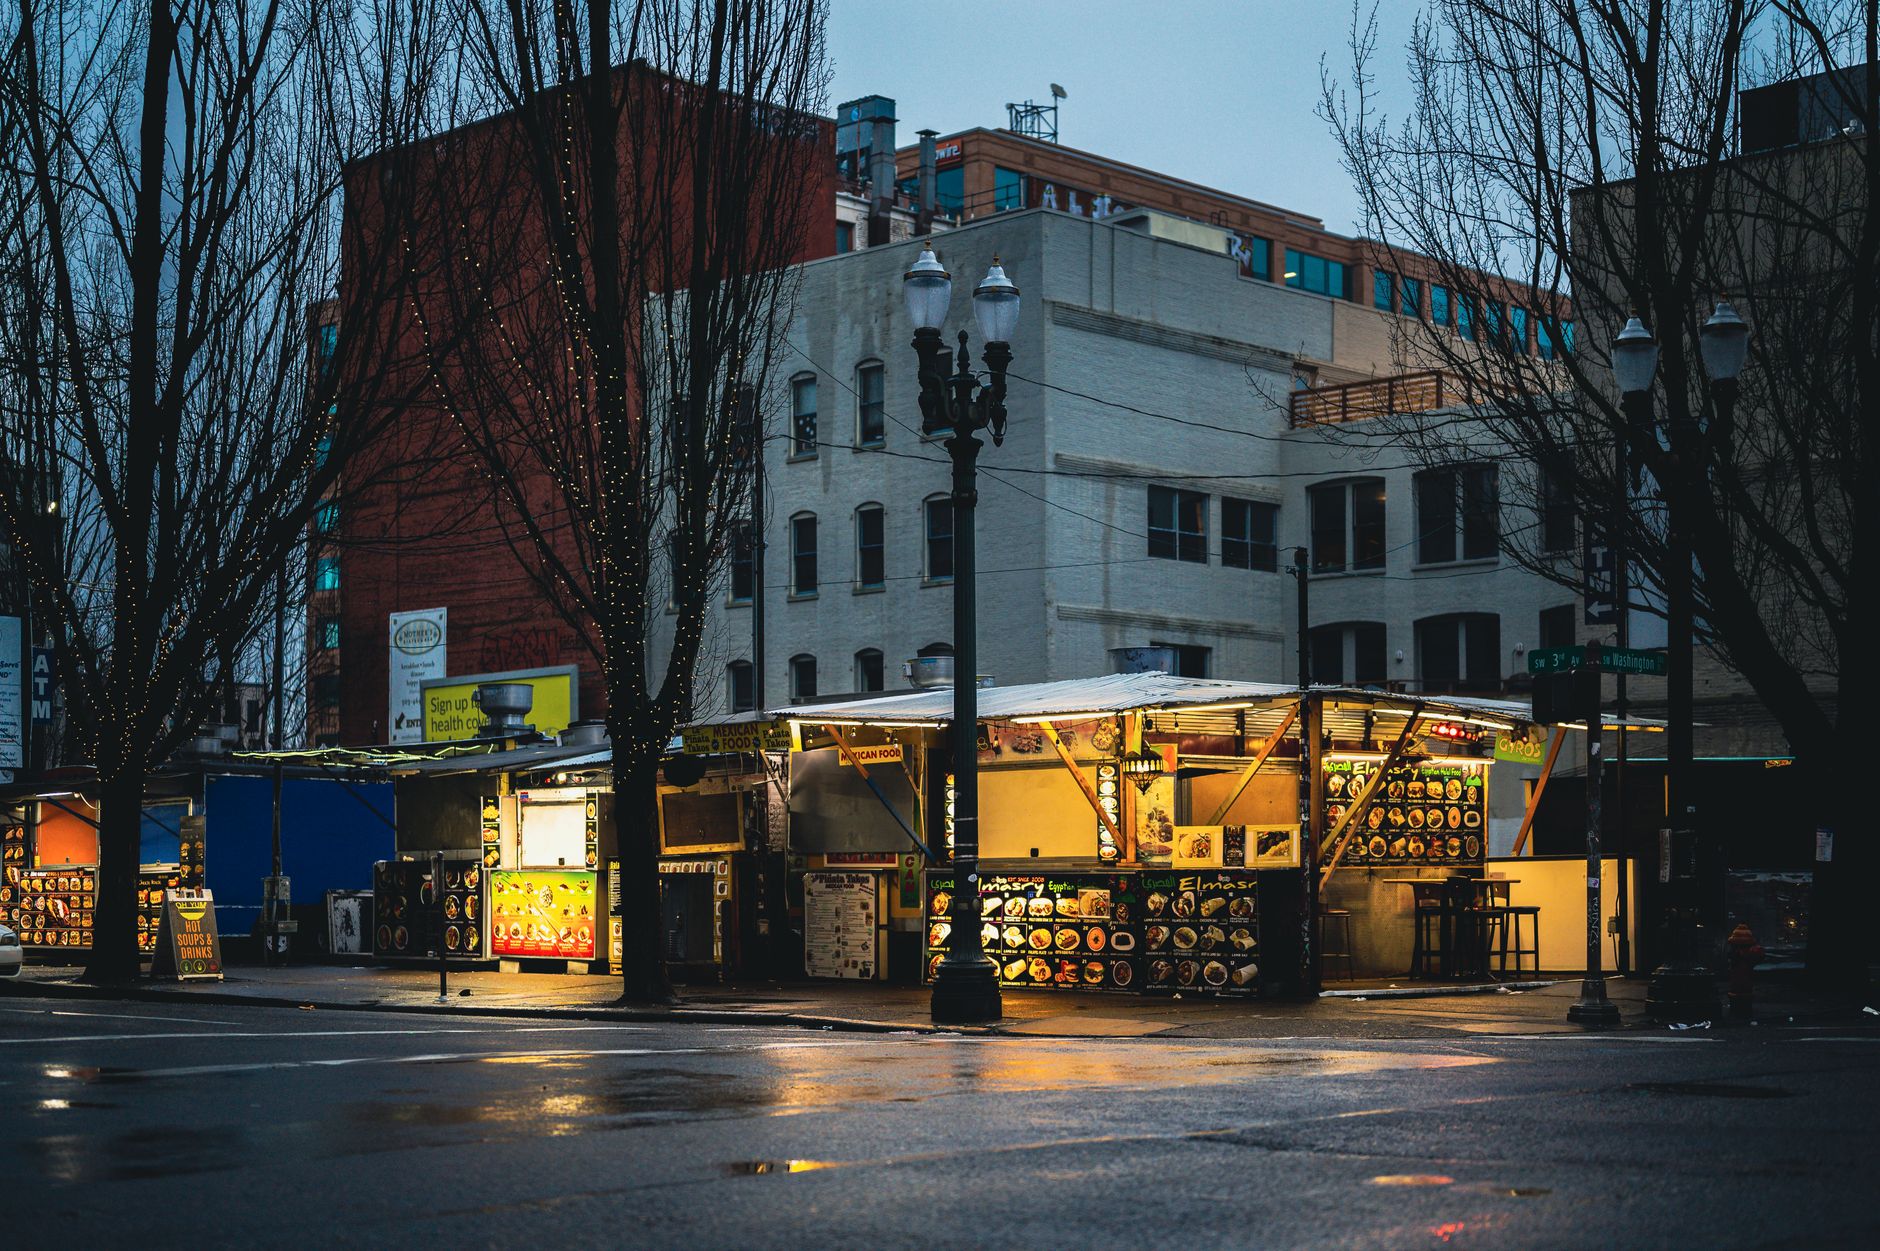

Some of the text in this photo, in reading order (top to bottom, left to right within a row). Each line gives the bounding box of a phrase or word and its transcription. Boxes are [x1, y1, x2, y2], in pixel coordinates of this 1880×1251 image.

[1534, 658, 1545, 669] SW
[1553, 652, 1565, 667] 3rd
[1612, 652, 1655, 673] Washington
[32, 654, 51, 719] ATM
[431, 697, 452, 715] Sign
[455, 699, 468, 713] up
[431, 715, 463, 733] health
[713, 724, 758, 737] MEXICAN
[722, 737, 751, 749] FOOD
[765, 739, 789, 748] Takos
[1499, 738, 1541, 758] GYROS
[841, 749, 901, 761] MXICAN FOOD
[978, 877, 1044, 898] lmasry
[185, 920, 201, 933] HOT
[177, 933, 213, 946] SOUPS &
[181, 946, 213, 960] DRINKS
